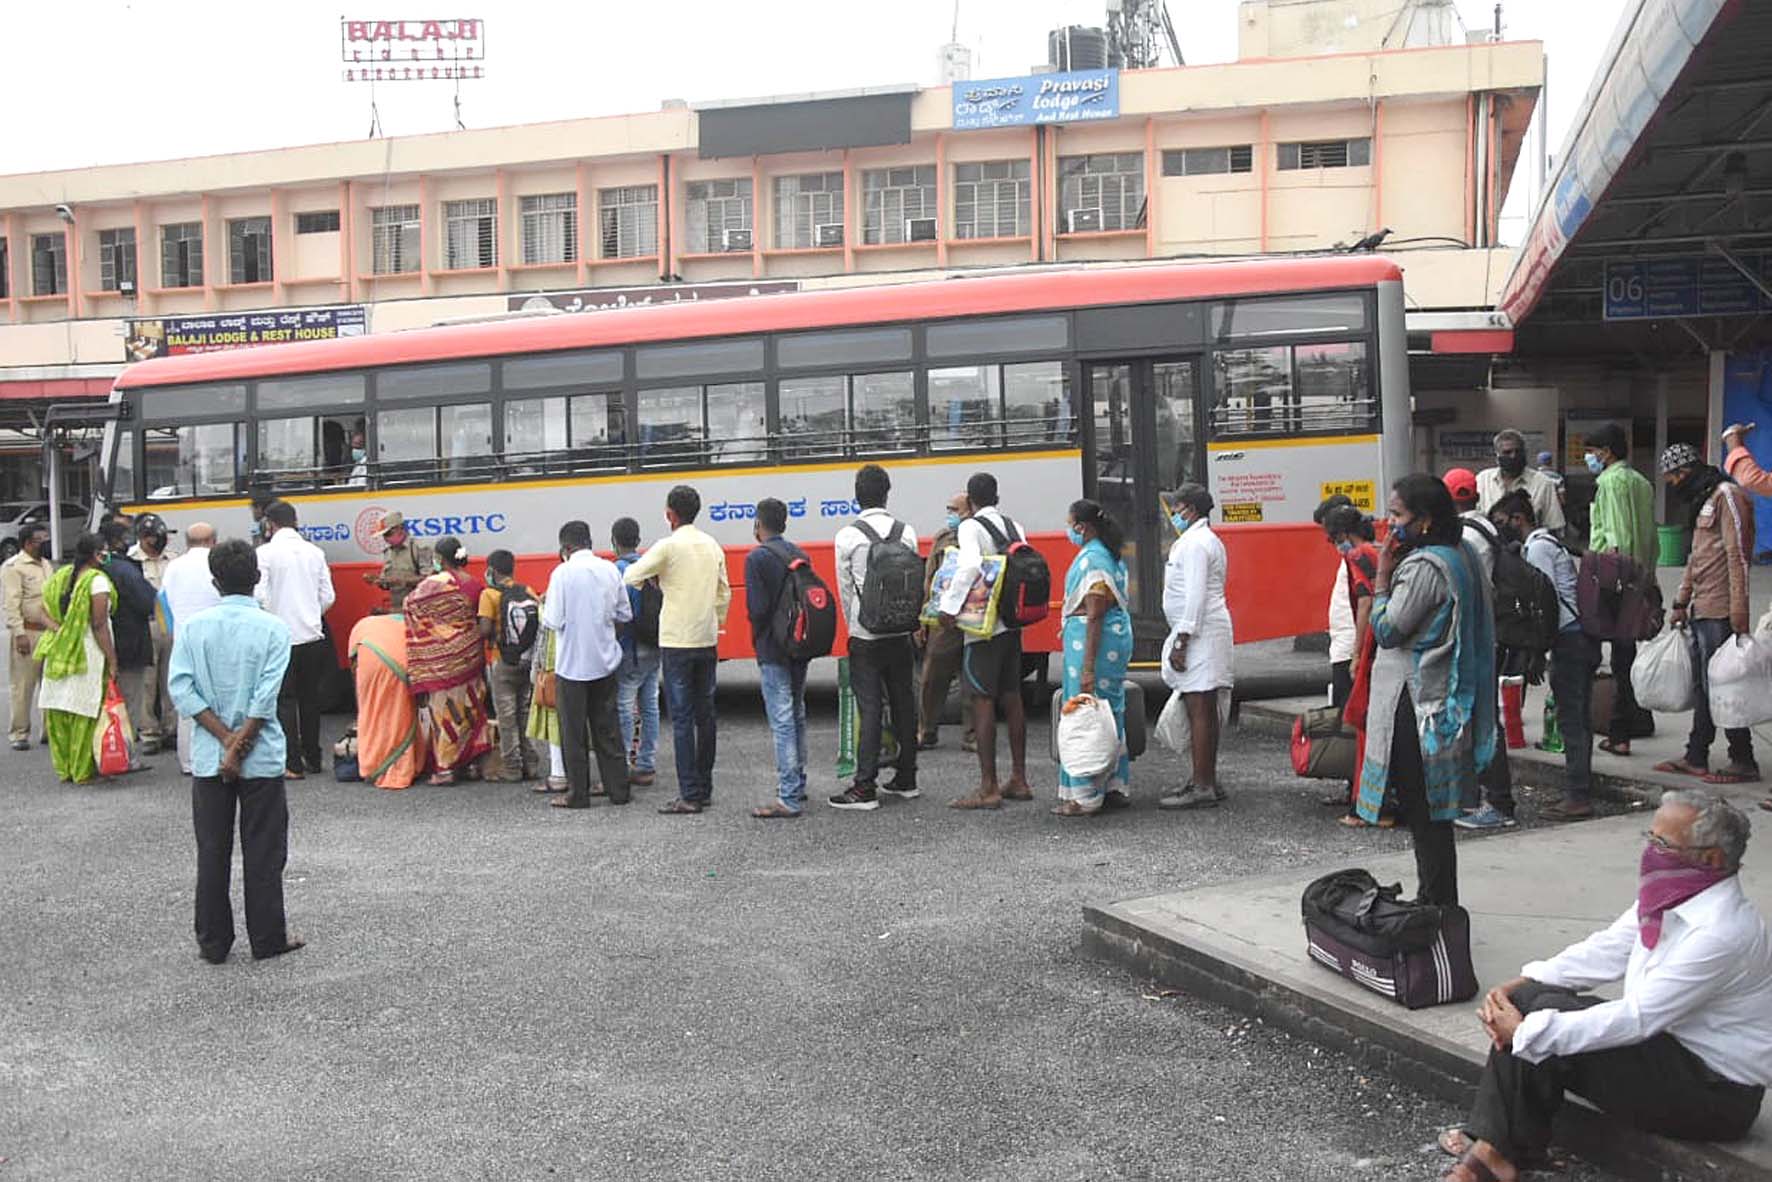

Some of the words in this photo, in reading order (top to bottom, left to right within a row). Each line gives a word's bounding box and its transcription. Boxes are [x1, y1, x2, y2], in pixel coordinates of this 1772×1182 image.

[1040, 74, 1110, 94] Pravasi
[1032, 93, 1079, 110] Lodge
[1609, 275, 1642, 302] 06
[167, 333, 207, 346] BALAJI
[209, 331, 247, 344] LODGE
[250, 330, 259, 342] &
[262, 328, 292, 342] REST
[294, 326, 336, 340] HOUSE
[405, 513, 506, 537] KSRTC
